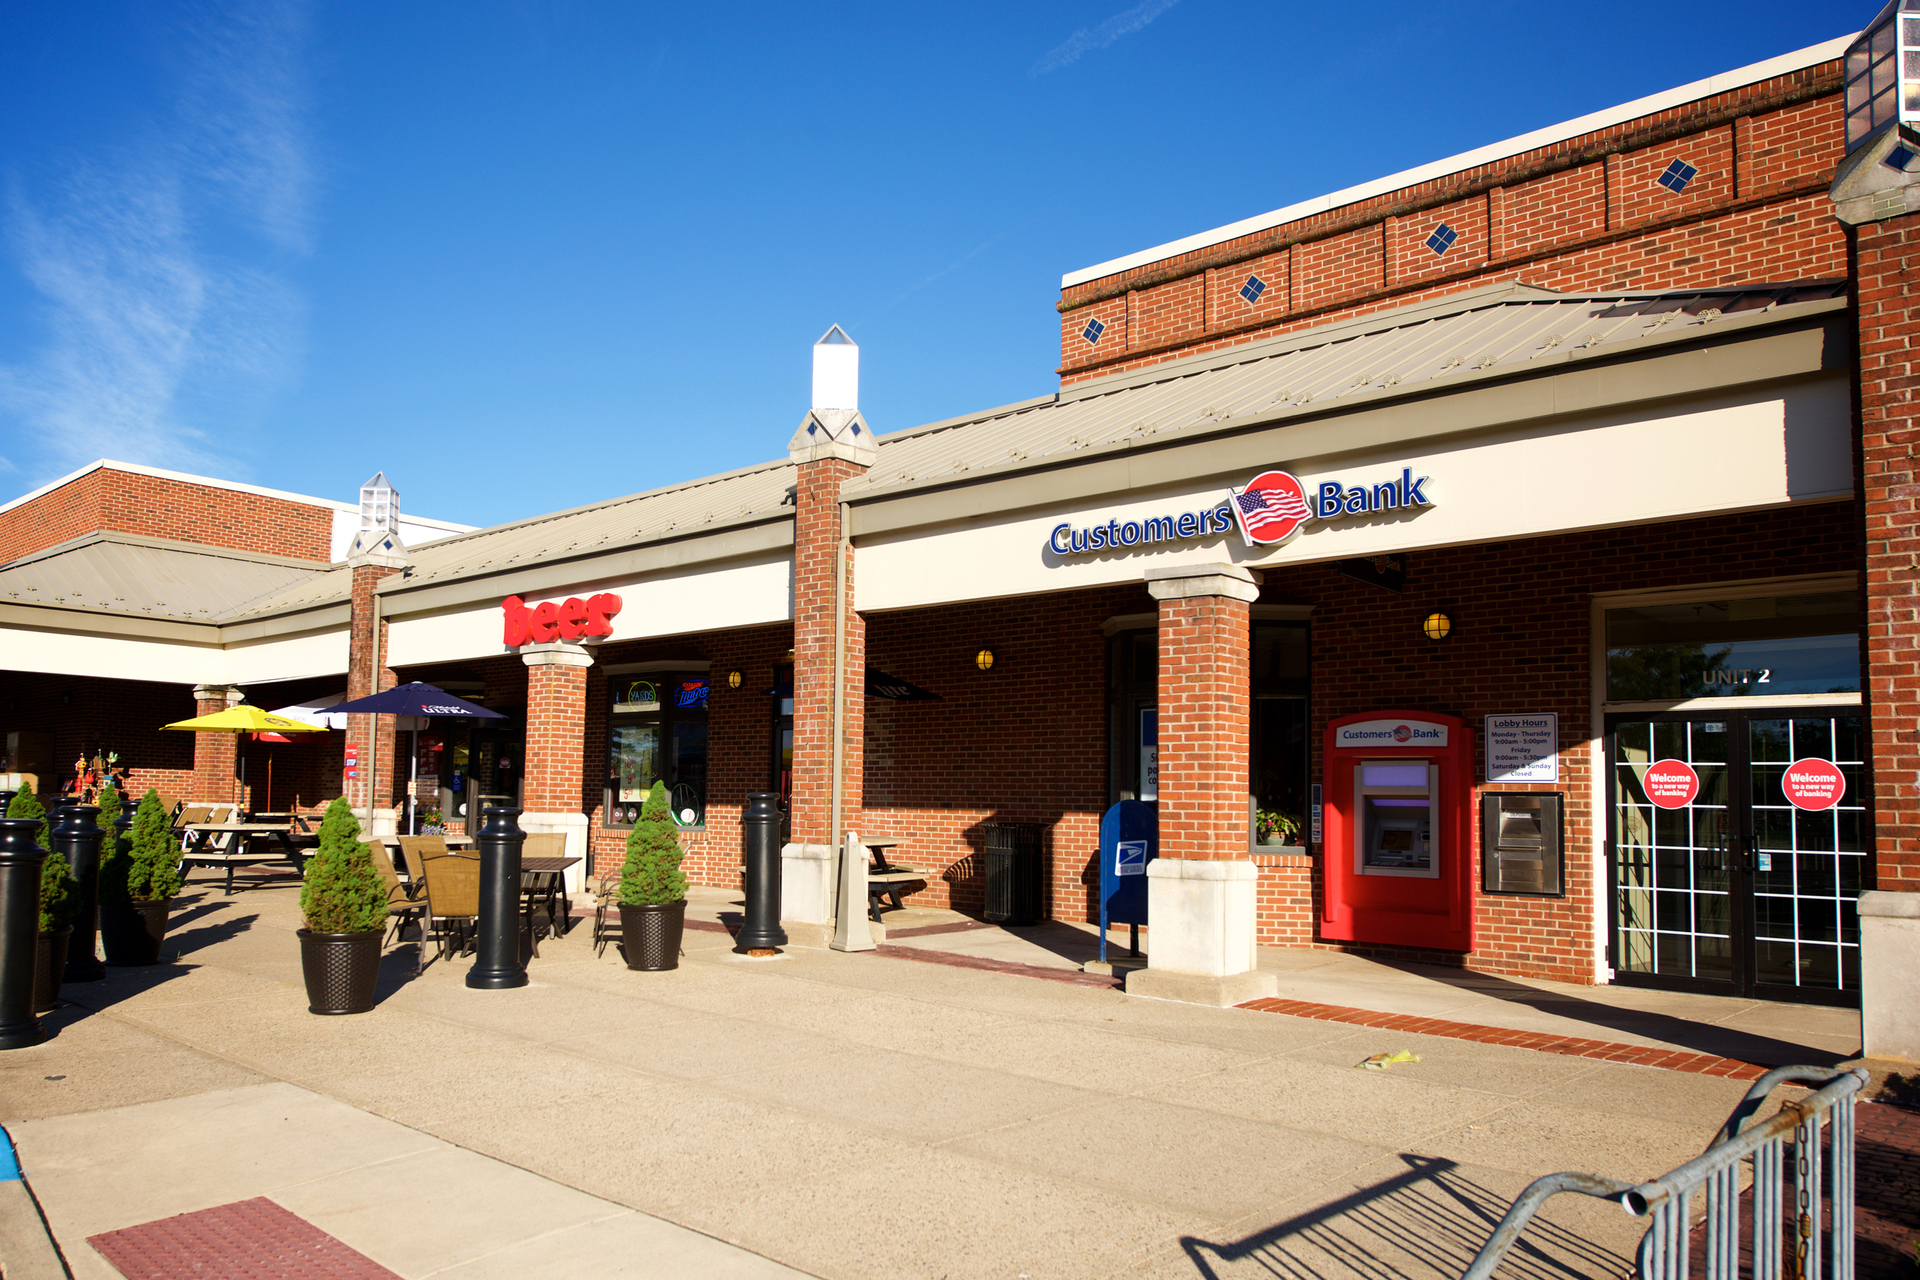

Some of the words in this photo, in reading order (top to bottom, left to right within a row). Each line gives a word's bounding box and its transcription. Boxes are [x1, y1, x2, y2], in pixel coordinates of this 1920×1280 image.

[1050, 504, 1231, 555] Customers
[1317, 465, 1430, 519] Bank
[501, 592, 623, 648] beer
[1703, 669, 1752, 685] UNIT
[1757, 668, 1771, 683] 2
[630, 690, 655, 702] YARDS
[1494, 720, 1520, 728] Lobby
[1522, 719, 1548, 727] Hours
[1343, 730, 1392, 739] Customers
[1413, 728, 1440, 738] Bank
[1650, 773, 1692, 782] Welcome
[1790, 772, 1836, 782] Welcome
[1804, 790, 1832, 798] banking
